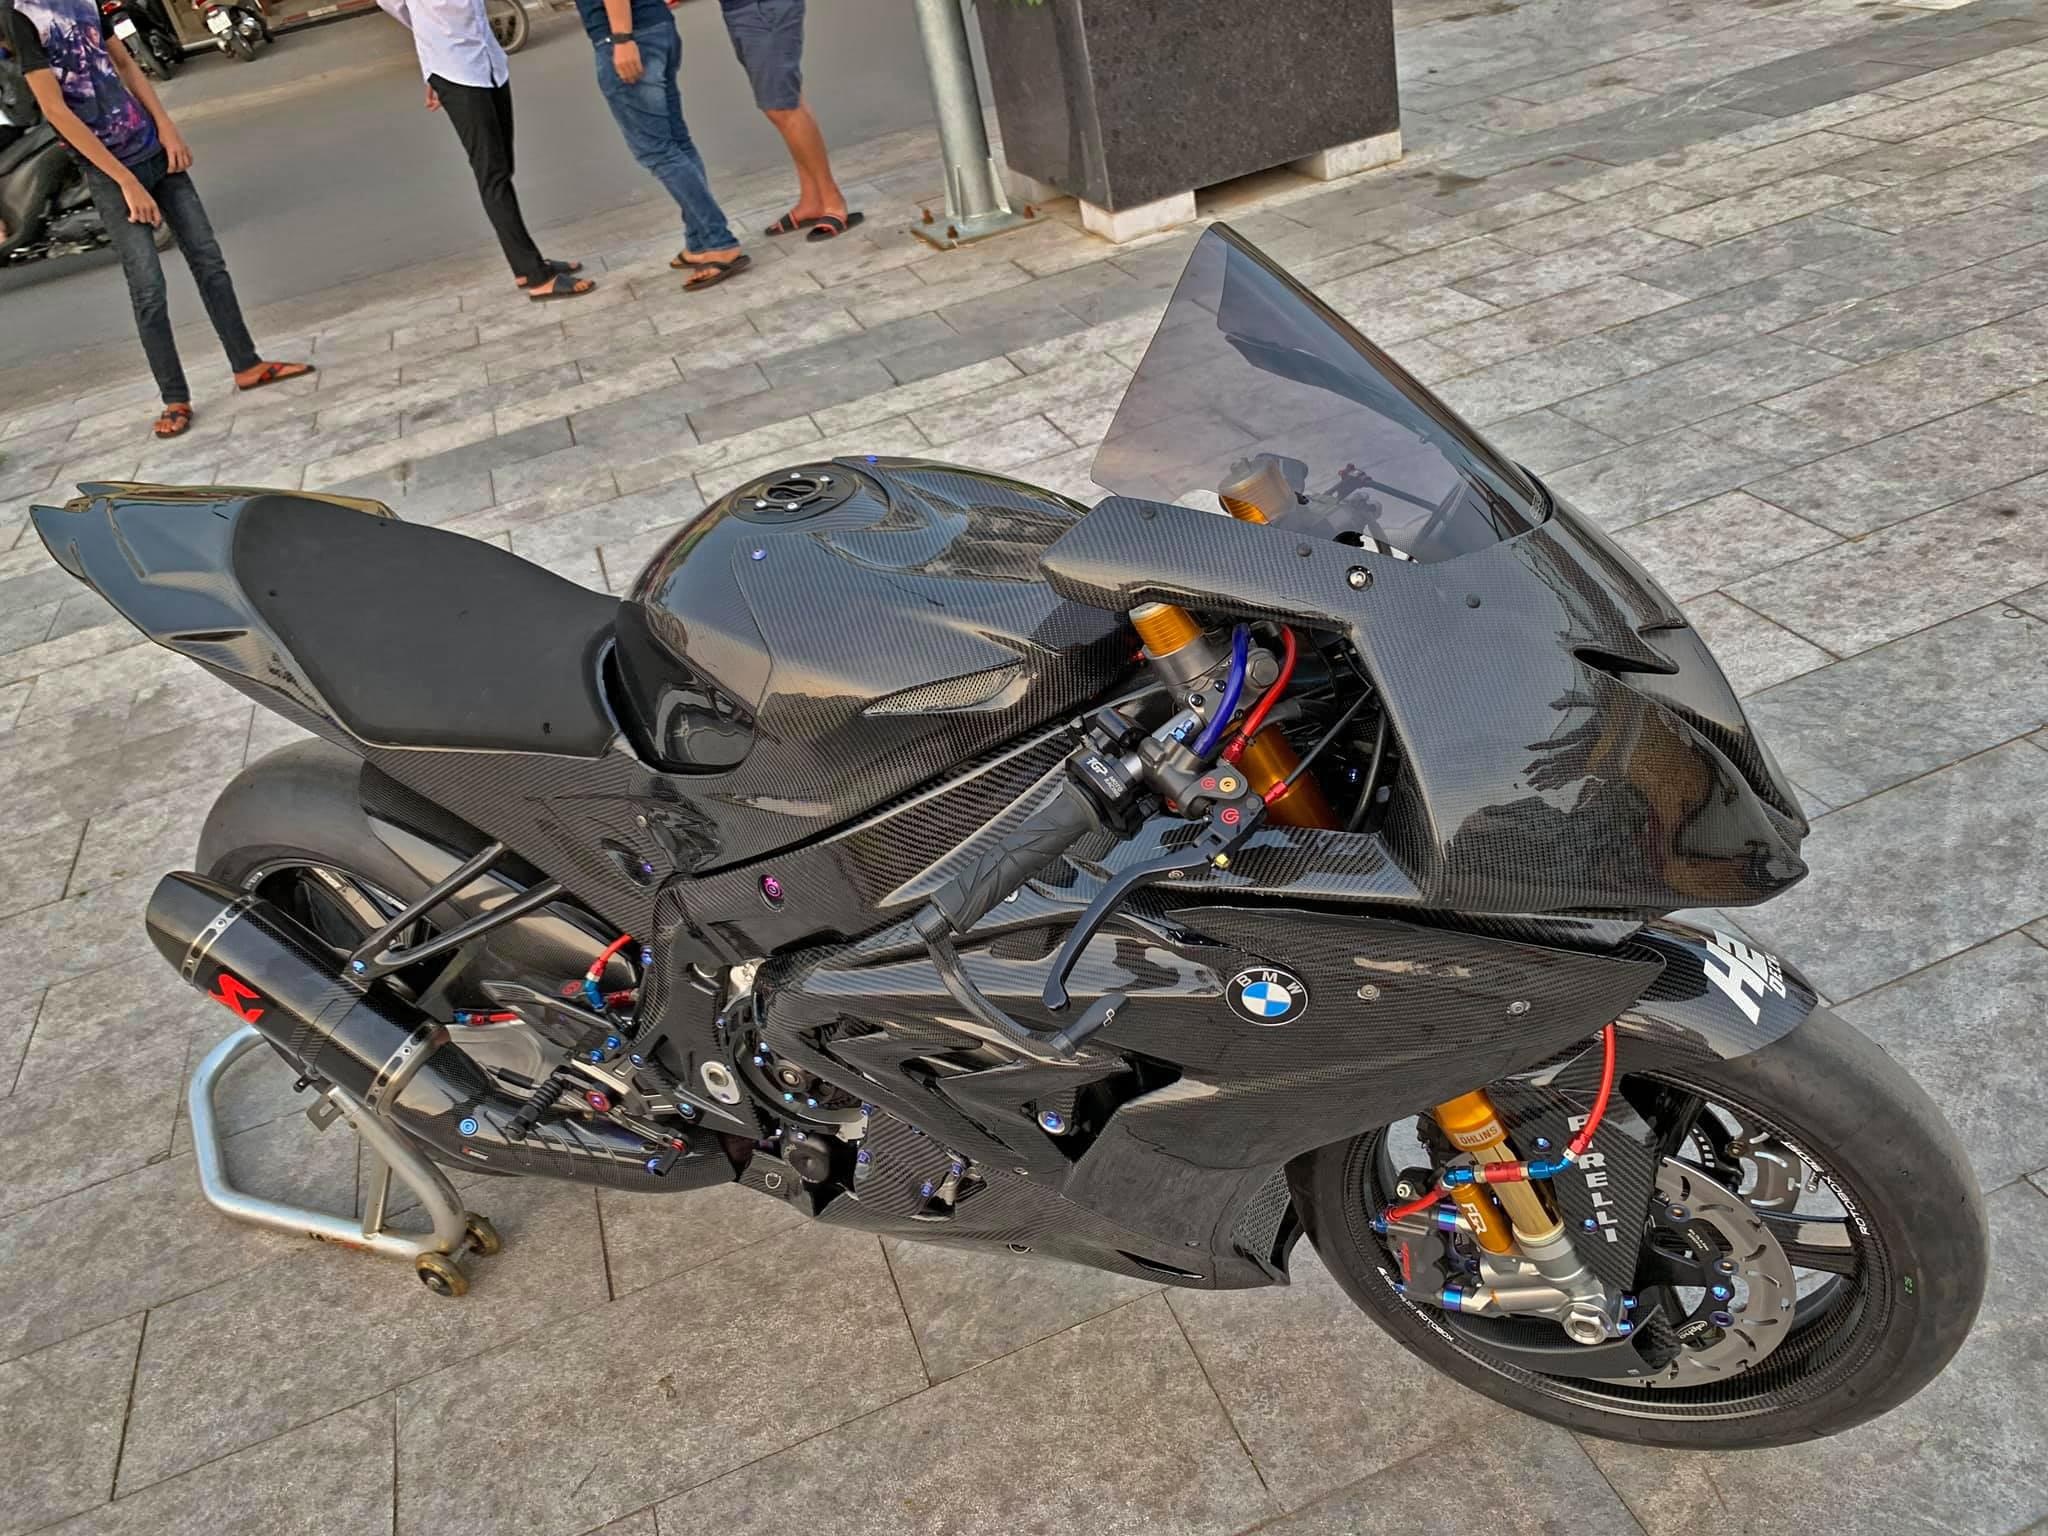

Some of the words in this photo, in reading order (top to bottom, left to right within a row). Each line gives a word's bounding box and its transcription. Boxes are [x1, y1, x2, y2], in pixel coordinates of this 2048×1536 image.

[1236, 971, 1303, 995] BMW
[1568, 1113, 1618, 1243] PRELLI
[1461, 1203, 1488, 1235] FGR
[1822, 1175, 1871, 1236] ROTOBOX
[1416, 1309, 1455, 1342] ROTOBOX
